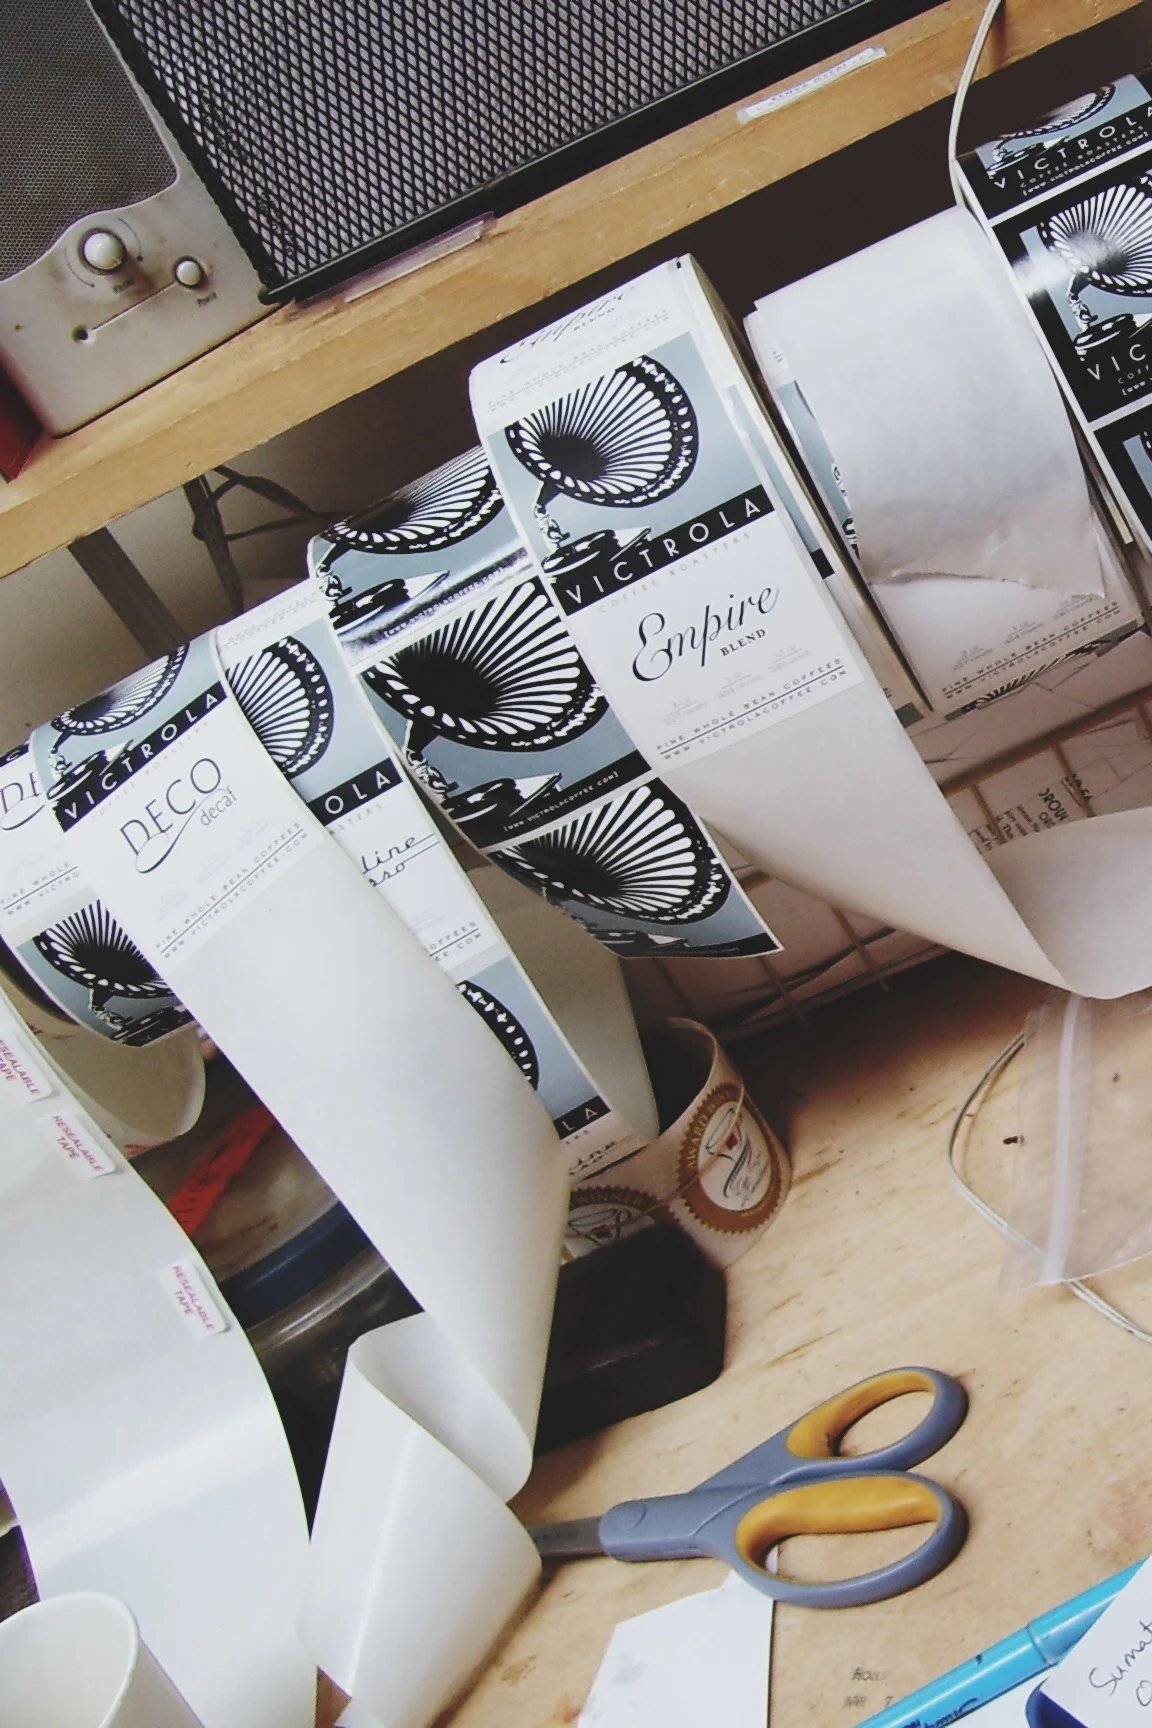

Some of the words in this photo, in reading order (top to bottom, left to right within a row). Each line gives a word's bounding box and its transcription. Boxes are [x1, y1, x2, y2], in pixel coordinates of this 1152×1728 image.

[564, 498, 761, 604] VICTROLA
[600, 580, 658, 613] COFFEE
[668, 532, 751, 576] ROASTERS
[632, 587, 780, 682] Empire
[719, 627, 767, 657] BLEND
[656, 734, 685, 751] FINE
[692, 709, 735, 734] WHOLE
[743, 690, 776, 710] BEAN
[783, 658, 841, 690] COFFEES
[64, 693, 218, 819] VICTROLA
[119, 757, 222, 858] DECO
[199, 784, 238, 827] decaf
[324, 769, 391, 815] OLA
[52, 1113, 106, 1173] RESEALABLE
[56, 1135, 82, 1161] TAPE
[561, 1106, 598, 1133] LA
[171, 1263, 216, 1331] RESEALABLE
[174, 1288, 197, 1317] TAPE
